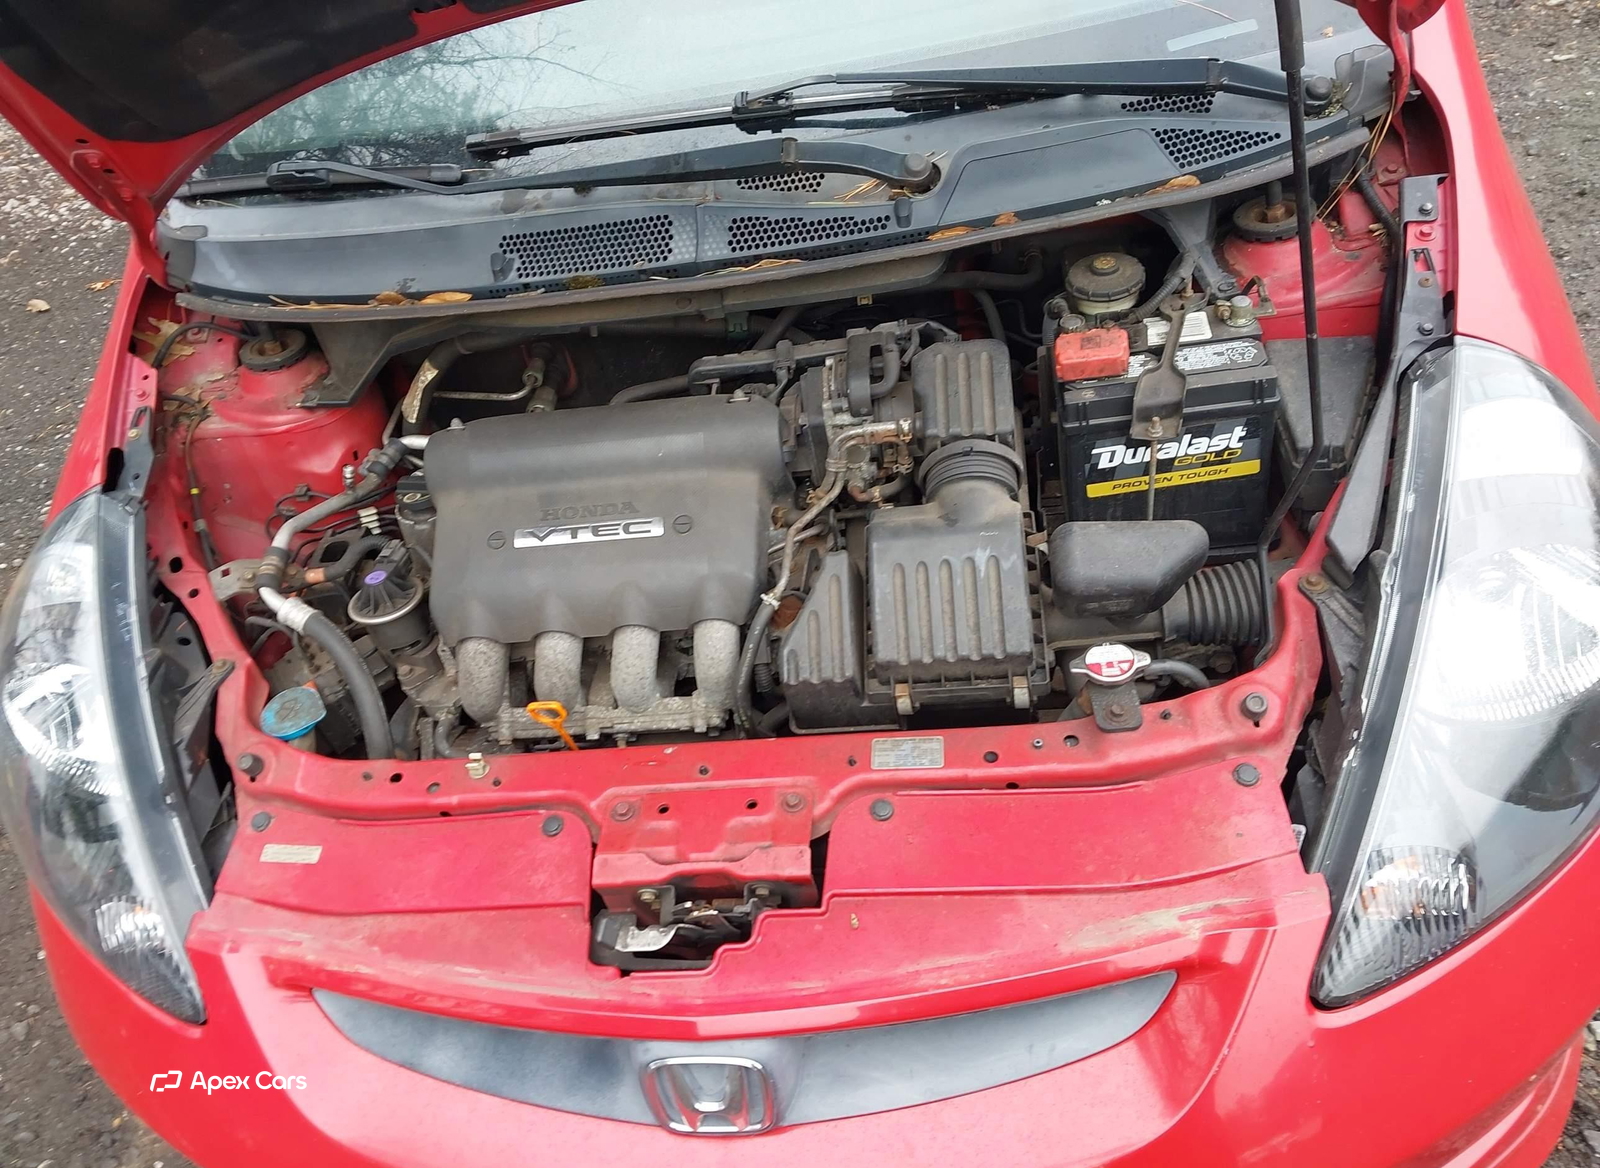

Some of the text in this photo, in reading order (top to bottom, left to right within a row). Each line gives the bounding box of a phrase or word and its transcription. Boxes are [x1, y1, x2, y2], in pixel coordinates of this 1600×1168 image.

[1091, 426, 1247, 469] Duralast
[1174, 449, 1242, 466] GOLD
[1112, 468, 1229, 490] PROVEN TOUGH
[540, 501, 640, 521] HONDA
[523, 519, 653, 542] VTEC
